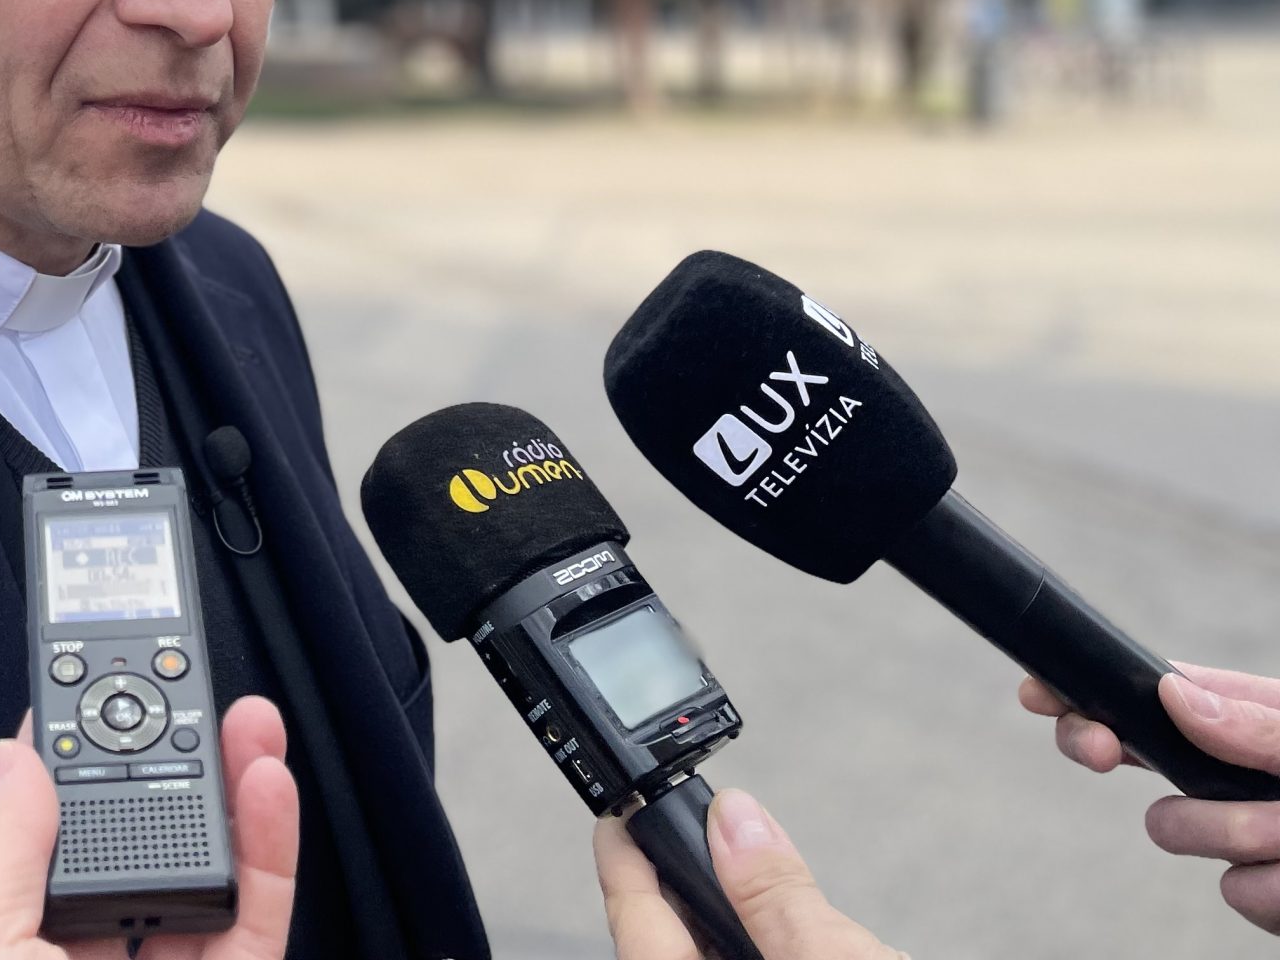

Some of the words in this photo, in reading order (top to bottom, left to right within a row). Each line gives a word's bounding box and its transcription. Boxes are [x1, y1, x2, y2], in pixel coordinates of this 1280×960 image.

[693, 350, 829, 487] LUX
[744, 395, 862, 507] TELEVÍZIA
[61, 490, 83, 502] OM
[85, 488, 149, 500] SYSTEM
[553, 550, 614, 585] ZOOM
[52, 642, 84, 653] STOP
[157, 636, 181, 647] REC
[49, 723, 76, 731] ERASE
[564, 737, 579, 754] OUT
[79, 768, 105, 777] MENU
[142, 765, 189, 775] CALENDAR
[162, 781, 190, 790] SCENE
[589, 782, 604, 797] USB
